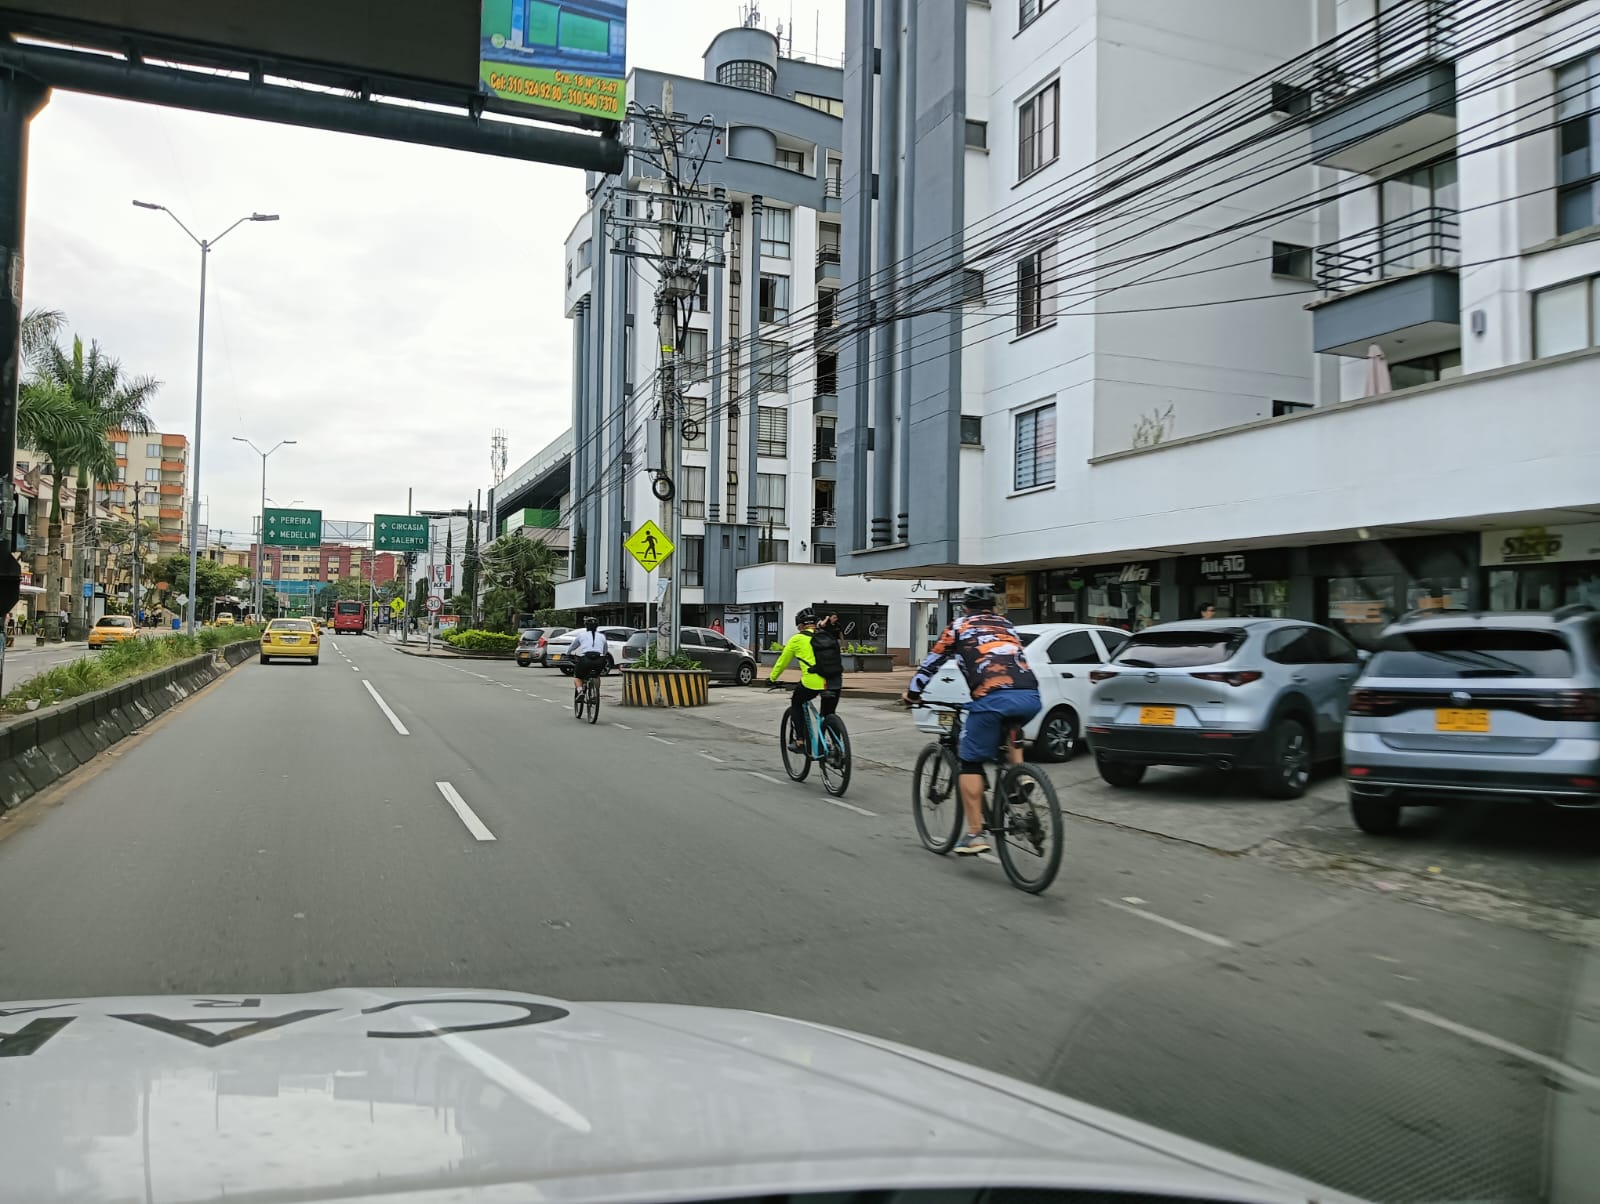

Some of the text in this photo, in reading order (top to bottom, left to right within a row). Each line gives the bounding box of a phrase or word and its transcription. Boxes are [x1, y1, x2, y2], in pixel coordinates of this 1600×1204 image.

[554, 70, 572, 84] Cra.
[490, 72, 506, 90] Cel:
[508, 75, 523, 94] 310
[524, 79, 539, 97] 524
[540, 82, 550, 99] 92
[568, 88, 582, 106] 310
[583, 91, 598, 109] 540
[280, 516, 312, 525] PEREIRA
[391, 523, 424, 531] CIRCASIA
[280, 531, 316, 539] MEDELLIN
[391, 537, 424, 545] SALENTO
[428, 600, 439, 608] 30
